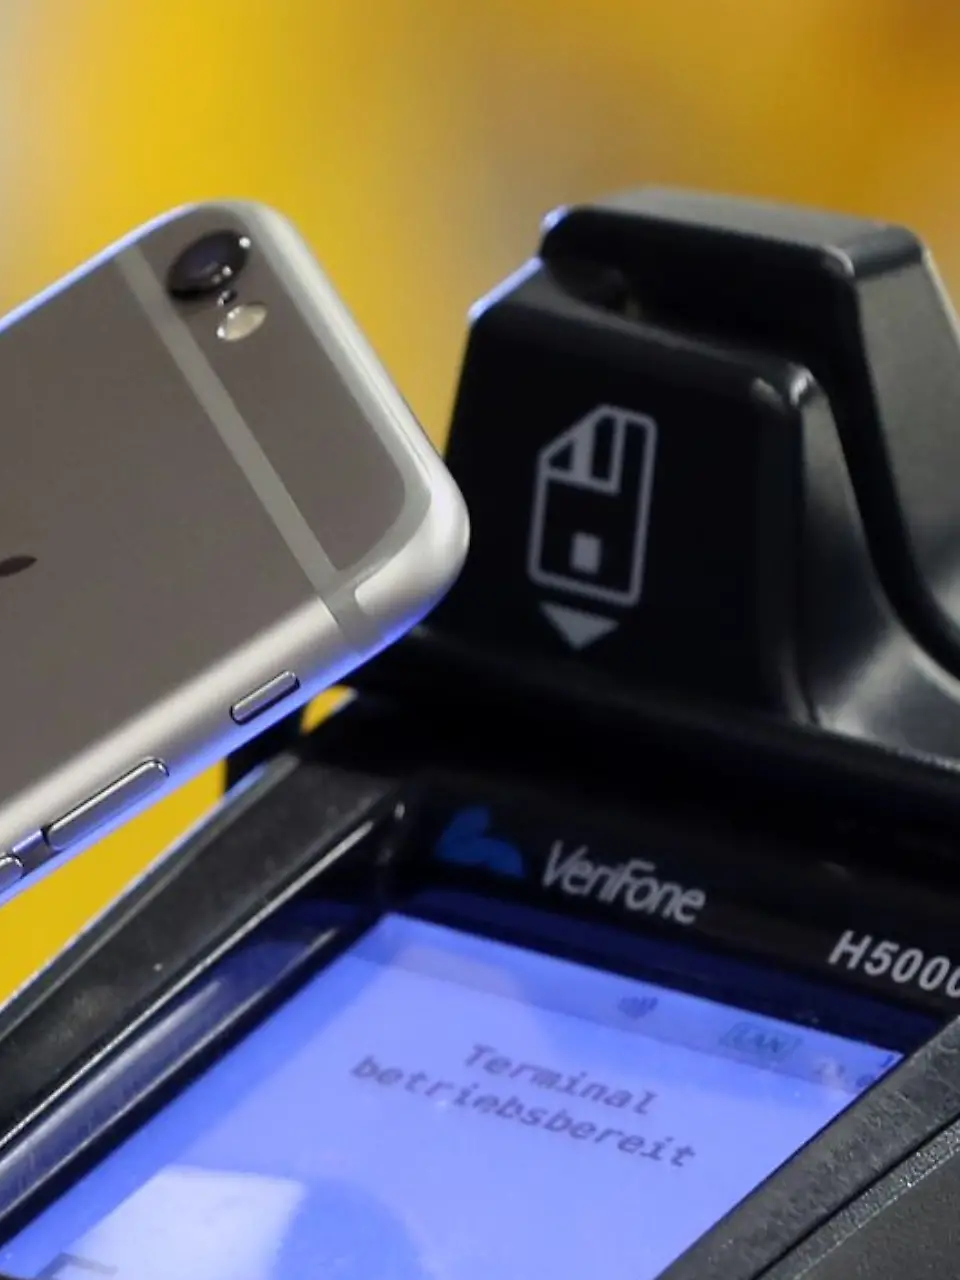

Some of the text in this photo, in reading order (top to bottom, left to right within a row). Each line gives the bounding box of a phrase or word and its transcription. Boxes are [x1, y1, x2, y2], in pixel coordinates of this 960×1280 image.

[543, 839, 706, 924] VeriFone
[351, 1055, 696, 1168] betriebsbereit
[465, 1043, 658, 1116] Terminal
